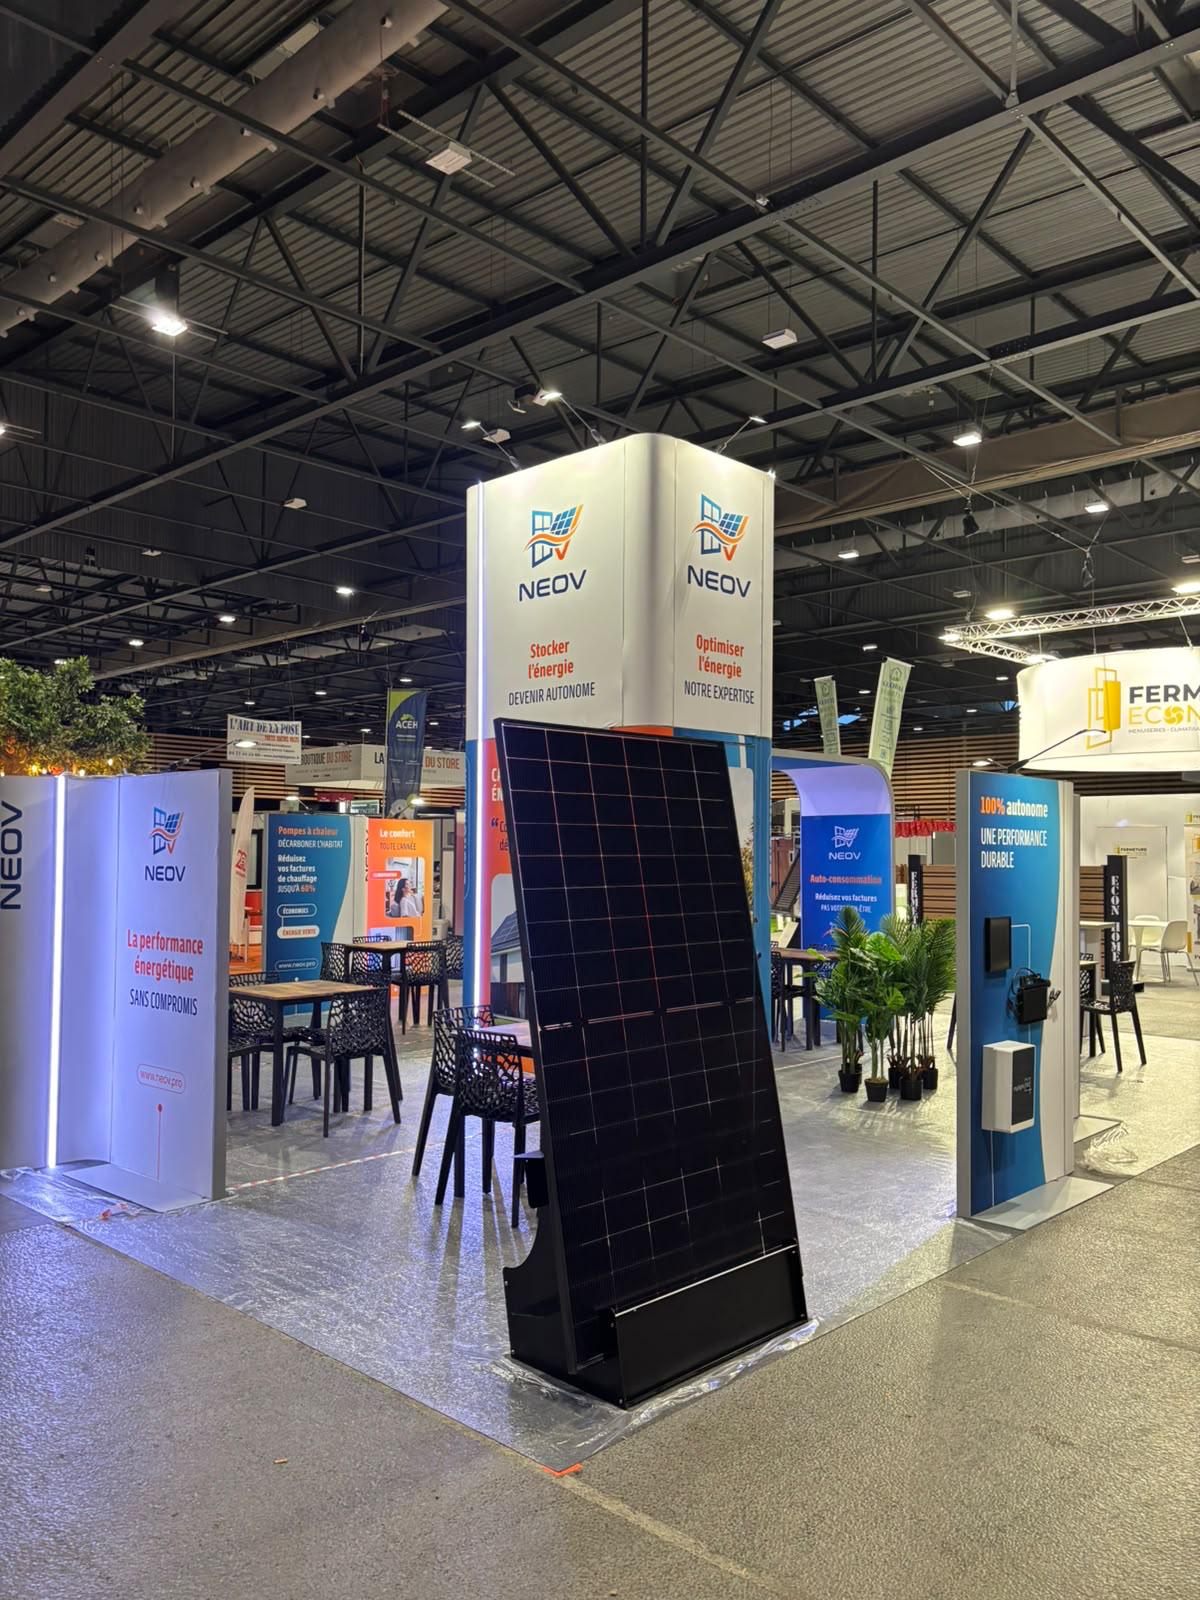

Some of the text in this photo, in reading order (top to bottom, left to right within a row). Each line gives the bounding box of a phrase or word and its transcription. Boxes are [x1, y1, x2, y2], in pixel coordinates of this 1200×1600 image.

[518, 570, 587, 602] NEOV
[687, 564, 751, 598] NEOV
[530, 639, 570, 660] Stocker
[696, 634, 745, 658] Optimiser
[528, 659, 574, 680] l'énergie
[698, 655, 742, 679] l'énergie
[508, 682, 596, 706] DEVENIR AUTONOME
[684, 680, 755, 705] NOTRE EXPERTISE
[1129, 684, 1200, 704] FERM
[395, 720, 418, 729] ACEH
[326, 752, 334, 764] DU
[335, 750, 352, 763] STORE
[374, 752, 385, 765] LA
[425, 756, 460, 769] DU STORE
[980, 796, 1049, 818] 100% autonome
[278, 826, 338, 836] Pompes à chaleur
[380, 829, 416, 838] Le confort
[980, 827, 1048, 847] UNE PERFORMANCE
[278, 838, 343, 849] DÉCARBONER L'HABITAT
[380, 841, 416, 851] TOUTE L'ANNÉE
[0, 800, 23, 910] NEOV
[277, 854, 306, 863] Réduisez
[828, 852, 861, 860] NEOV
[981, 850, 1015, 868] DURABLE
[144, 866, 186, 882] NEOV
[278, 864, 316, 873] vos factures
[277, 874, 318, 884] de chauffage
[810, 874, 882, 885] Auto-consommation
[277, 883, 300, 894] JUSQU'À
[815, 892, 841, 901] Réduisez
[852, 893, 877, 902] factures
[1111, 876, 1120, 916] ECON
[127, 929, 204, 955] La performance
[1111, 921, 1121, 963] HOME
[134, 955, 194, 983] énergétique
[278, 961, 316, 969] www.neov.pro
[130, 988, 198, 1016] SANS COMPROMIS
[139, 1070, 183, 1089] www.neov.pro
